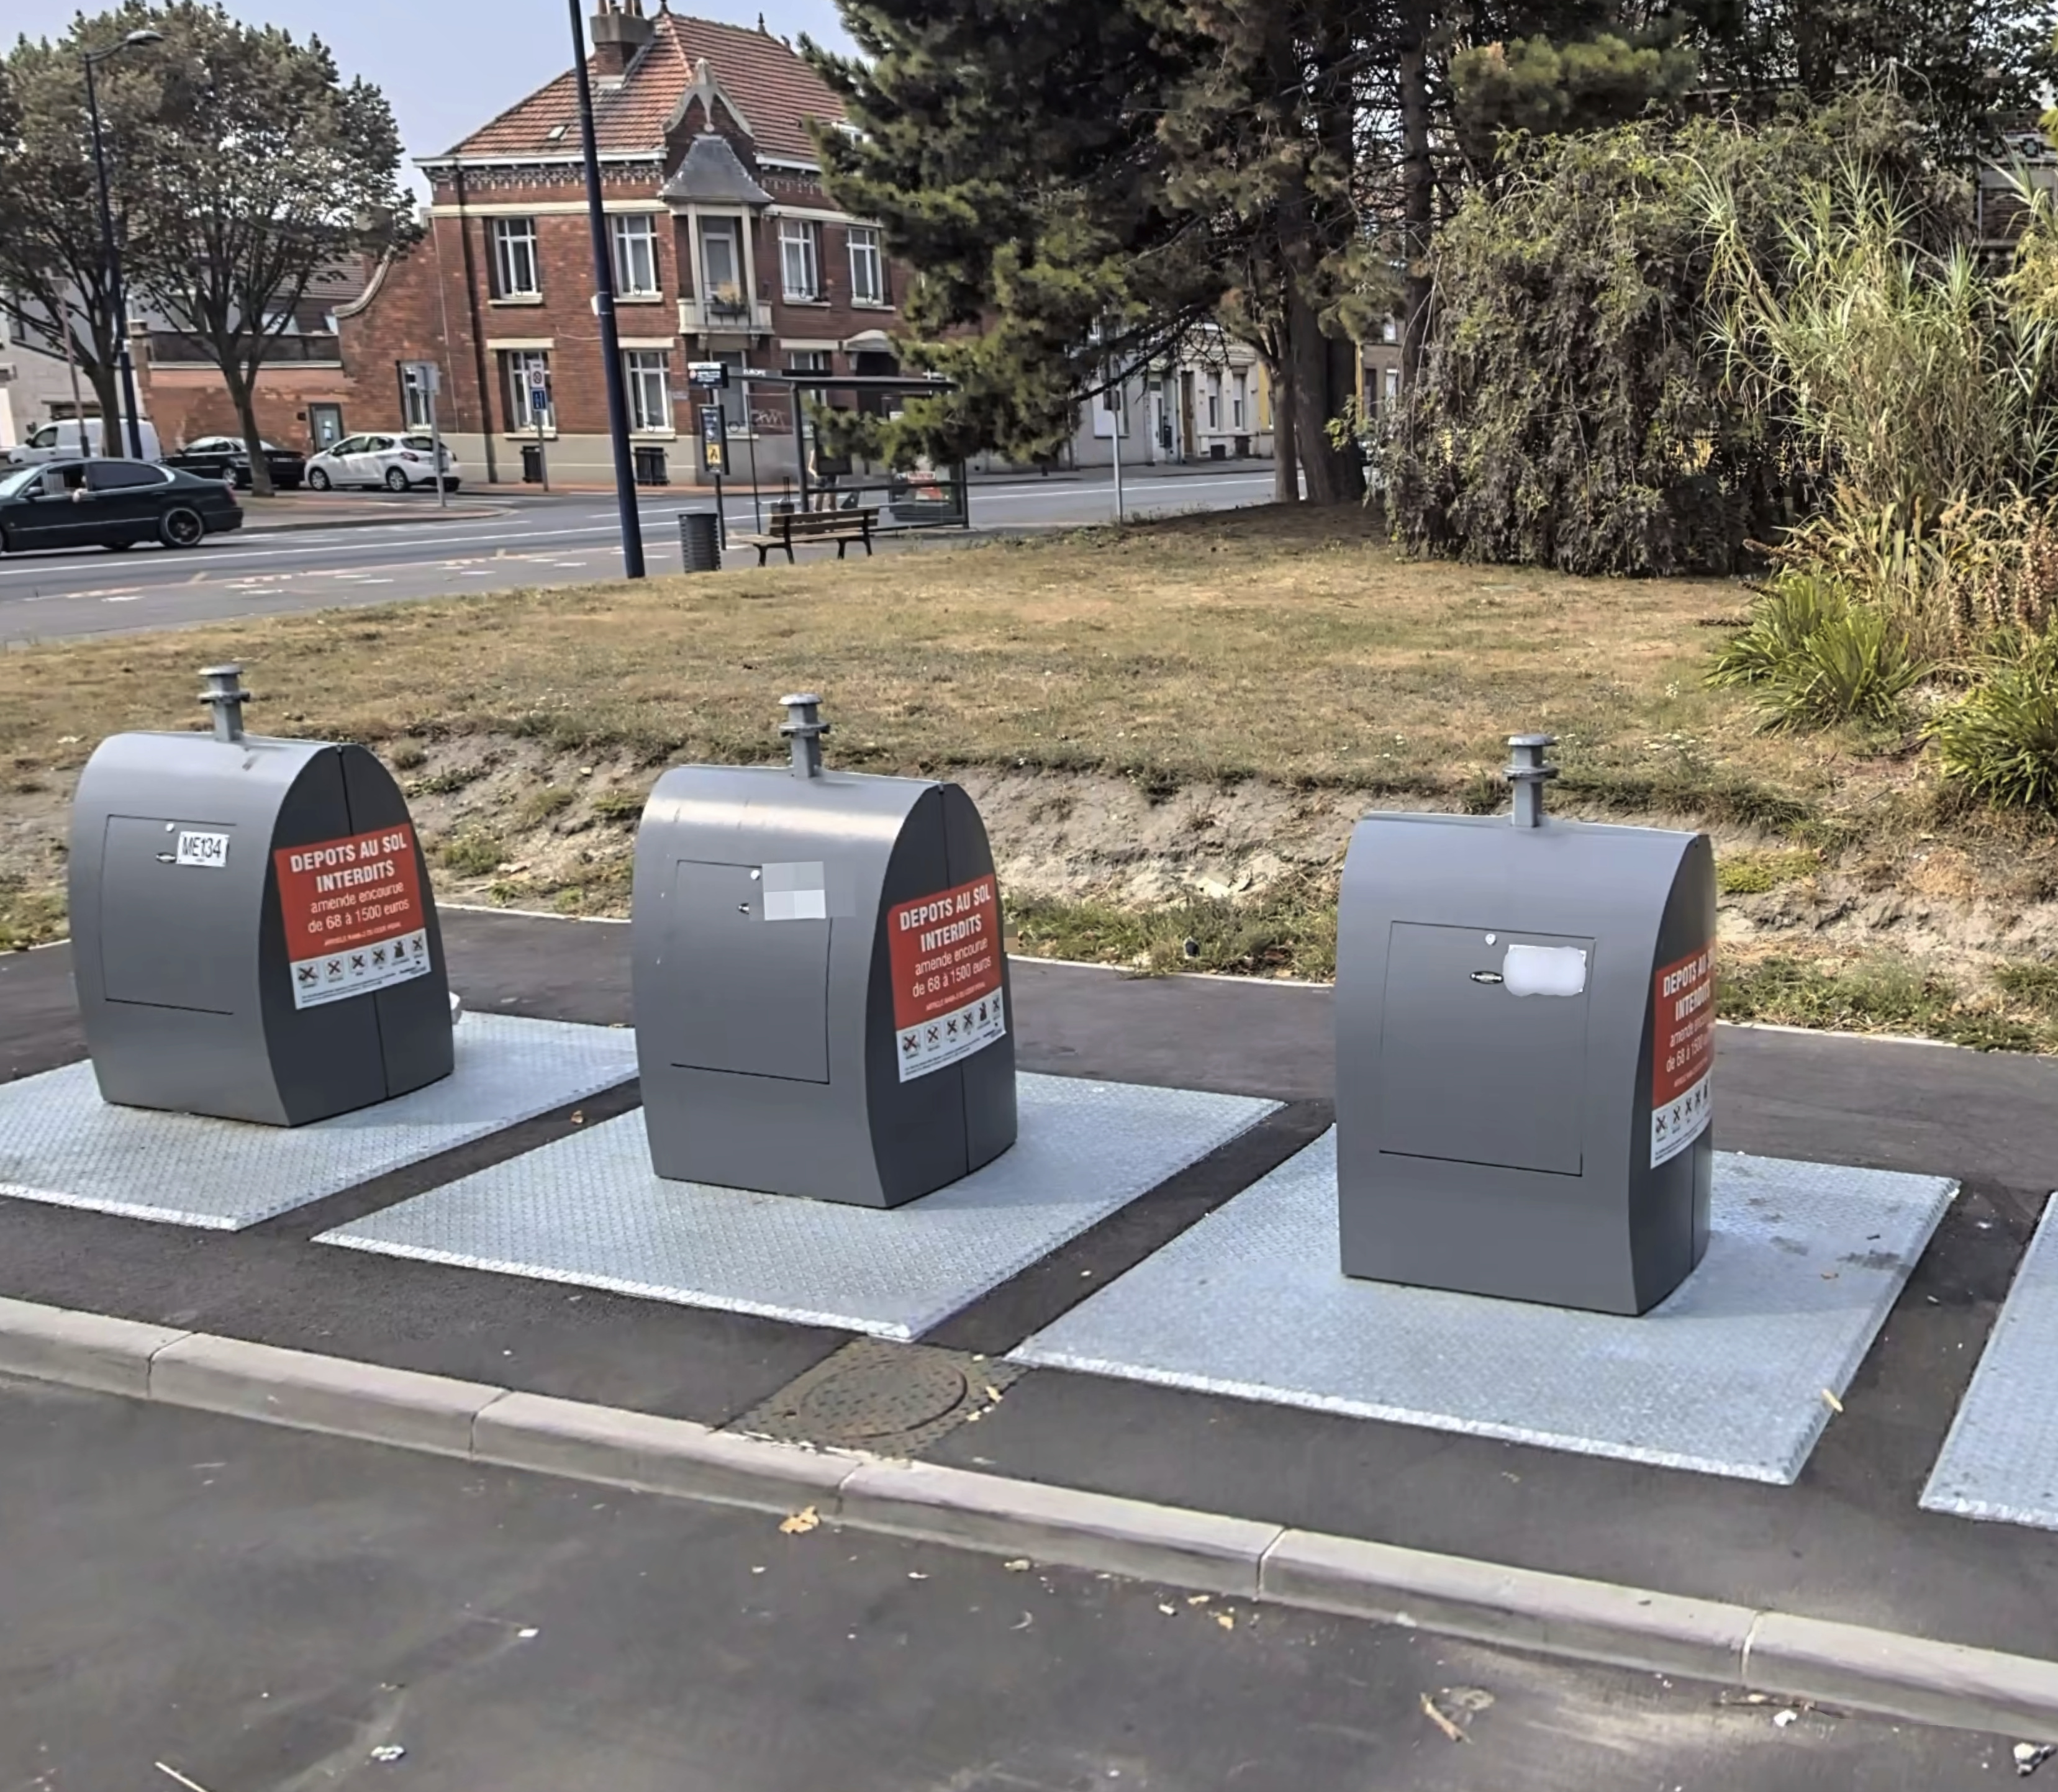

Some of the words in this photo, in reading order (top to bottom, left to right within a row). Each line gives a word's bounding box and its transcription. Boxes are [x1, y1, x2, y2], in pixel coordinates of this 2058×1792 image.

[183, 836, 221, 858] ME134
[291, 845, 356, 872] DEPOTS
[360, 839, 379, 859] AU
[383, 833, 407, 853] SOL
[316, 860, 395, 893] INTERDITS
[308, 918, 323, 933] de
[325, 914, 342, 930] 68
[345, 912, 353, 925] à
[356, 904, 381, 923] 1500
[384, 899, 410, 915] euros
[311, 893, 356, 914] amende
[359, 882, 404, 903] encourue
[900, 898, 953, 931] DEPOTS
[956, 892, 971, 914] AU
[974, 884, 991, 905] SOL
[920, 913, 982, 953] INTERDITS
[915, 951, 952, 976] amende
[954, 938, 988, 961] encourue
[912, 981, 925, 998] de
[927, 974, 941, 993] 68
[943, 972, 949, 987] à
[951, 962, 971, 984] 1500
[973, 956, 991, 975] euros
[1663, 960, 1697, 998] DEPOTS
[1670, 1020, 1693, 1048] amende
[1666, 1056, 1675, 1072] de
[1677, 1047, 1685, 1067] 68
